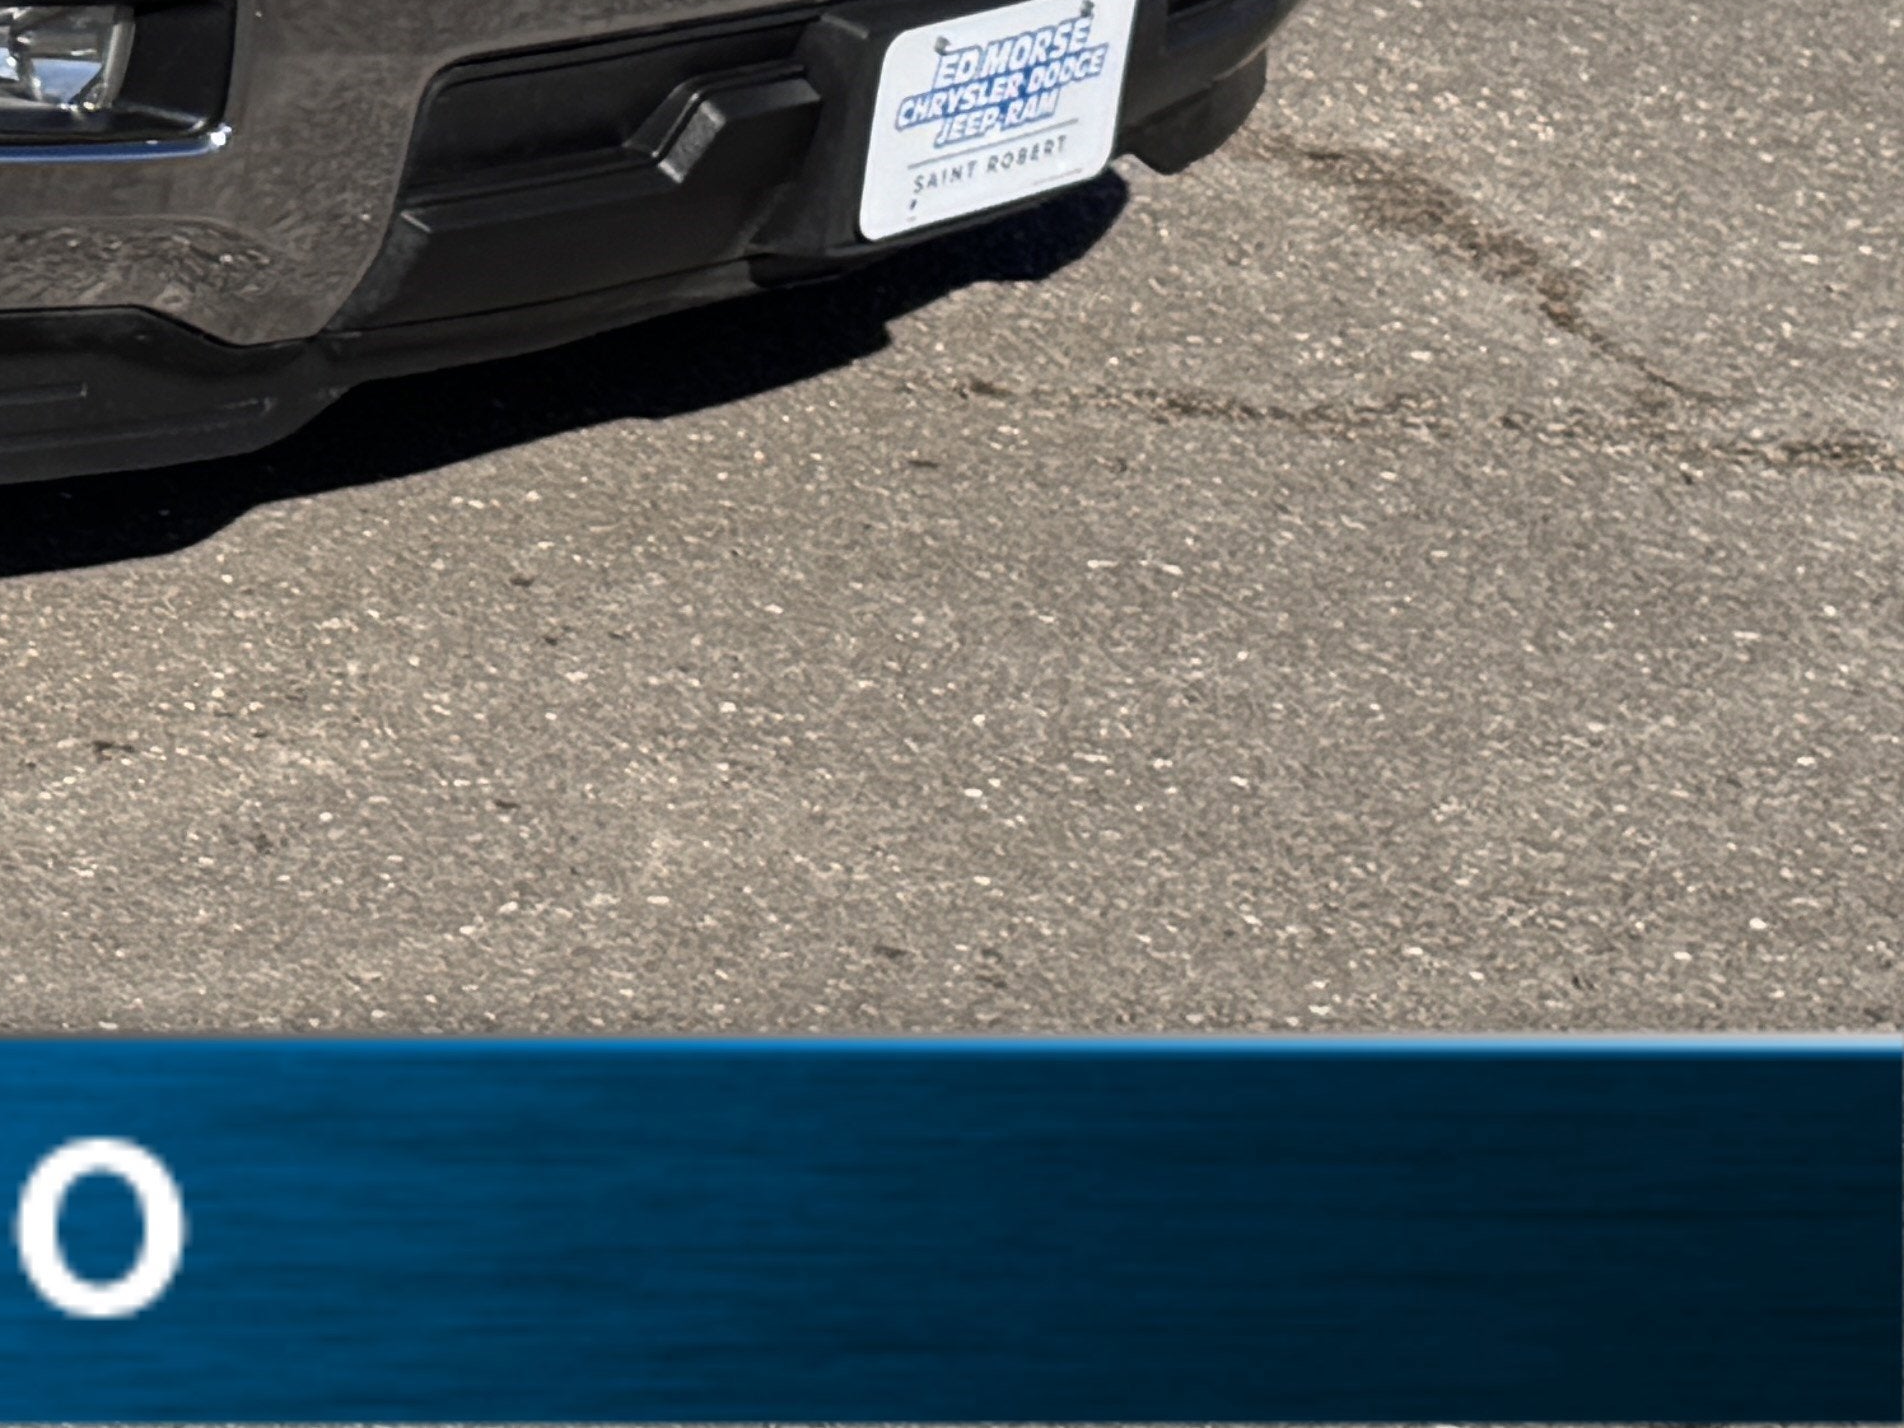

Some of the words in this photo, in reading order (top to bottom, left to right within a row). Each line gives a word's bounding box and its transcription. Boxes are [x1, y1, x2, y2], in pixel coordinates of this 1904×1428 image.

[897, 72, 1025, 127] CHRYSLER
[1027, 46, 1106, 93] DODGE
[934, 48, 980, 88] ED
[980, 17, 1093, 79] MORSE
[913, 160, 978, 194] SAINT
[986, 134, 1068, 173] ROBERT
